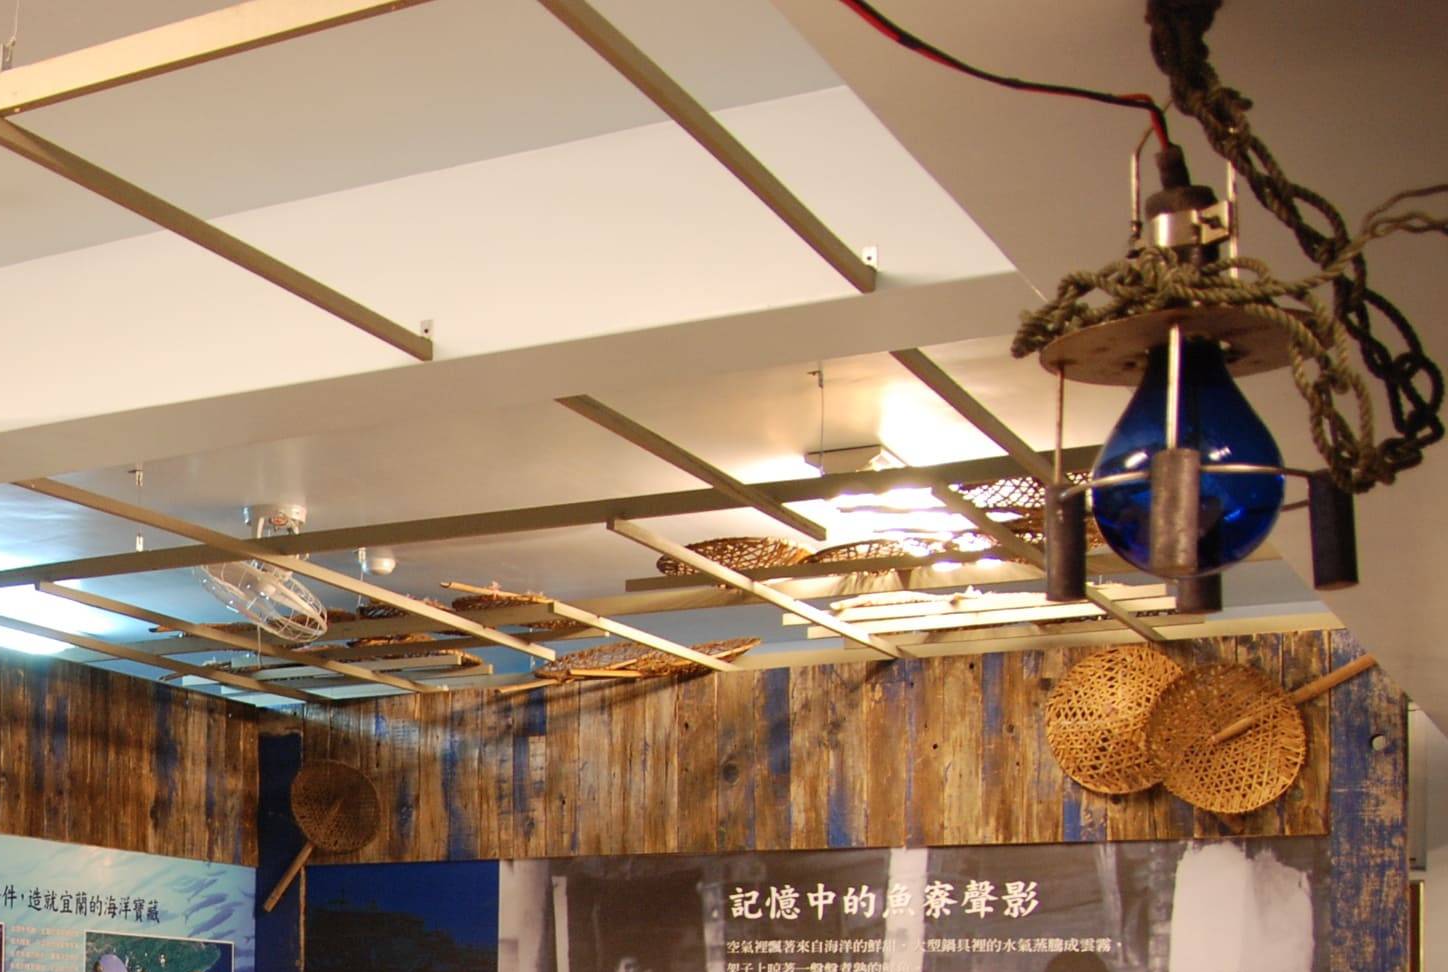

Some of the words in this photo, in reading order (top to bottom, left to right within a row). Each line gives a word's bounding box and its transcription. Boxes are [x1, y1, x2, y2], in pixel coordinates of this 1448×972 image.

[728, 879, 1040, 920] 記憶中的魚寮聲影
